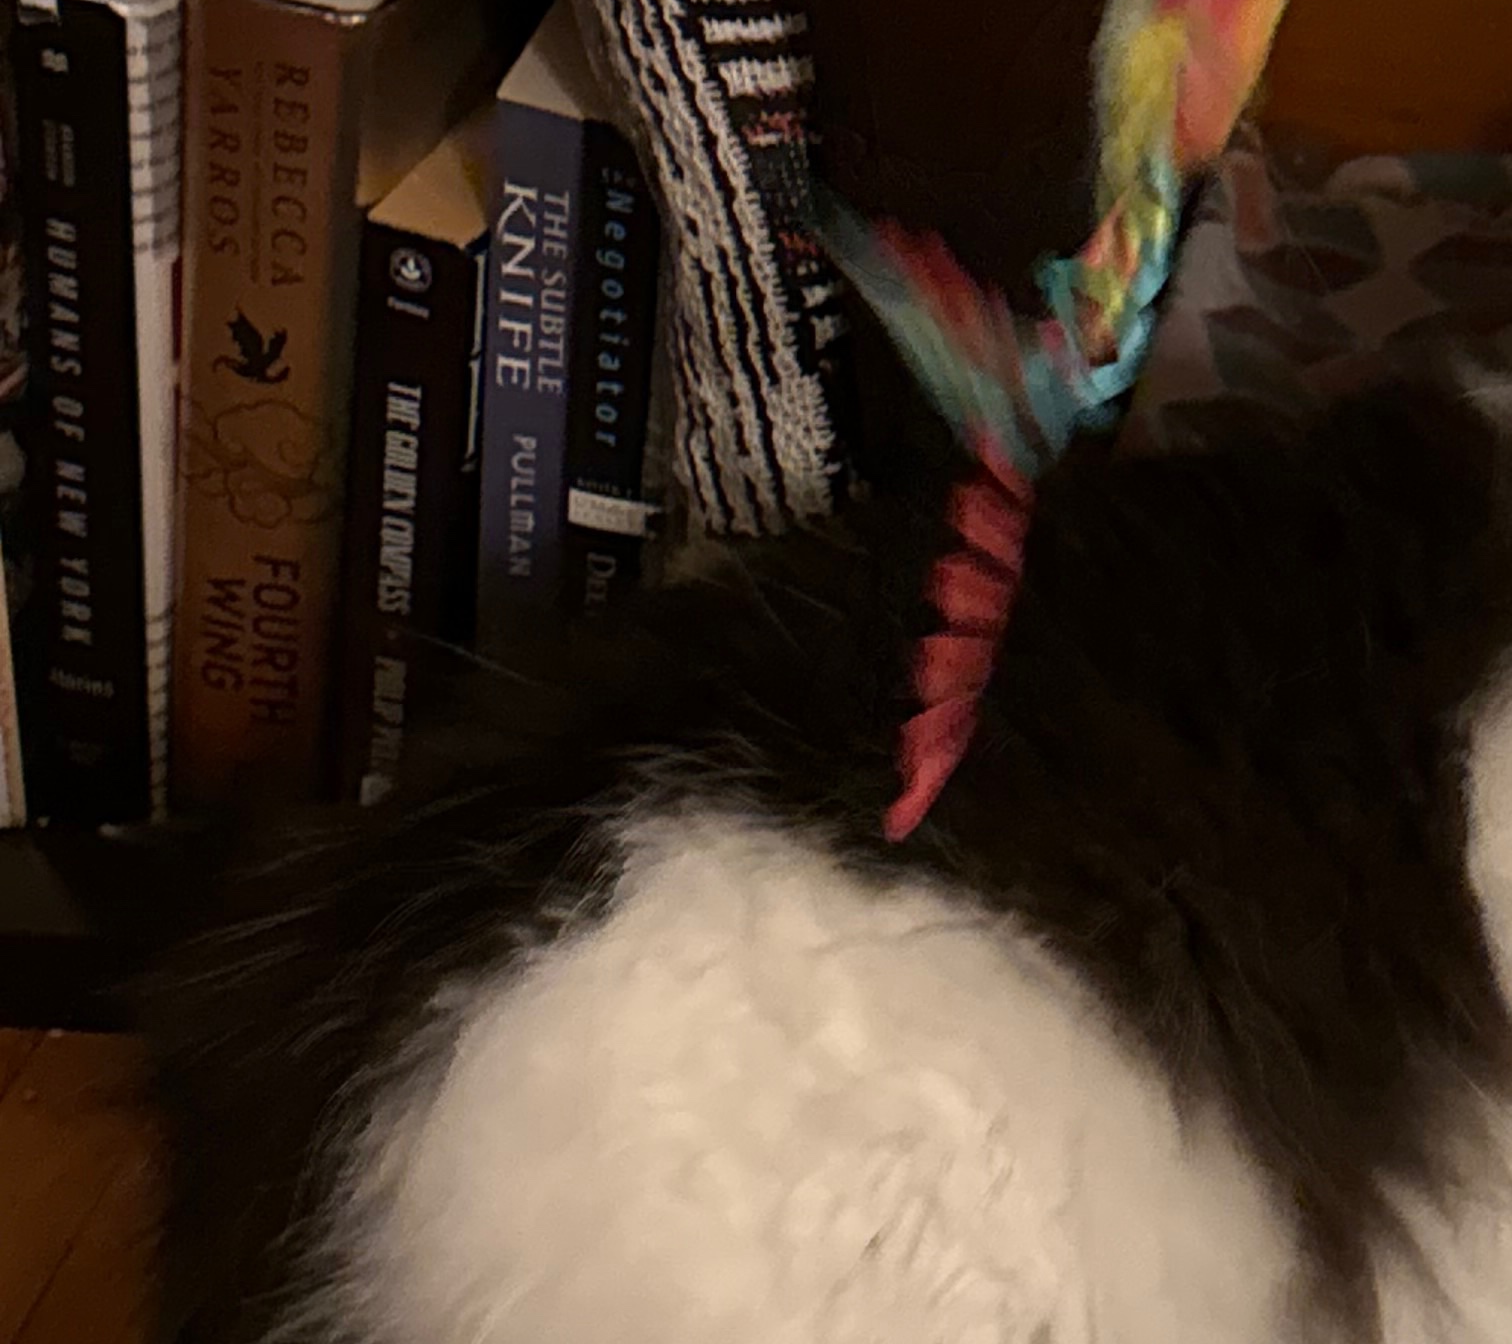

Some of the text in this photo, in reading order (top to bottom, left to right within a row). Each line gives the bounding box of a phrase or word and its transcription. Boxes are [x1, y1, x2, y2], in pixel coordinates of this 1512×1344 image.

[208, 63, 244, 257] YARROS
[270, 60, 312, 287] REBECCA
[45, 214, 83, 378] HUMANS
[495, 179, 538, 391] KNIFE
[537, 189, 570, 397] THE SUBTLE
[595, 186, 636, 449] Negotiator
[51, 392, 86, 444] OF
[385, 379, 422, 431] THE
[54, 456, 89, 540] NEW
[376, 514, 416, 616] COMPASS
[508, 432, 538, 577] PULLMAN
[58, 555, 96, 649] YORK
[201, 576, 246, 691] WING
[250, 554, 301, 727] FOURTH
